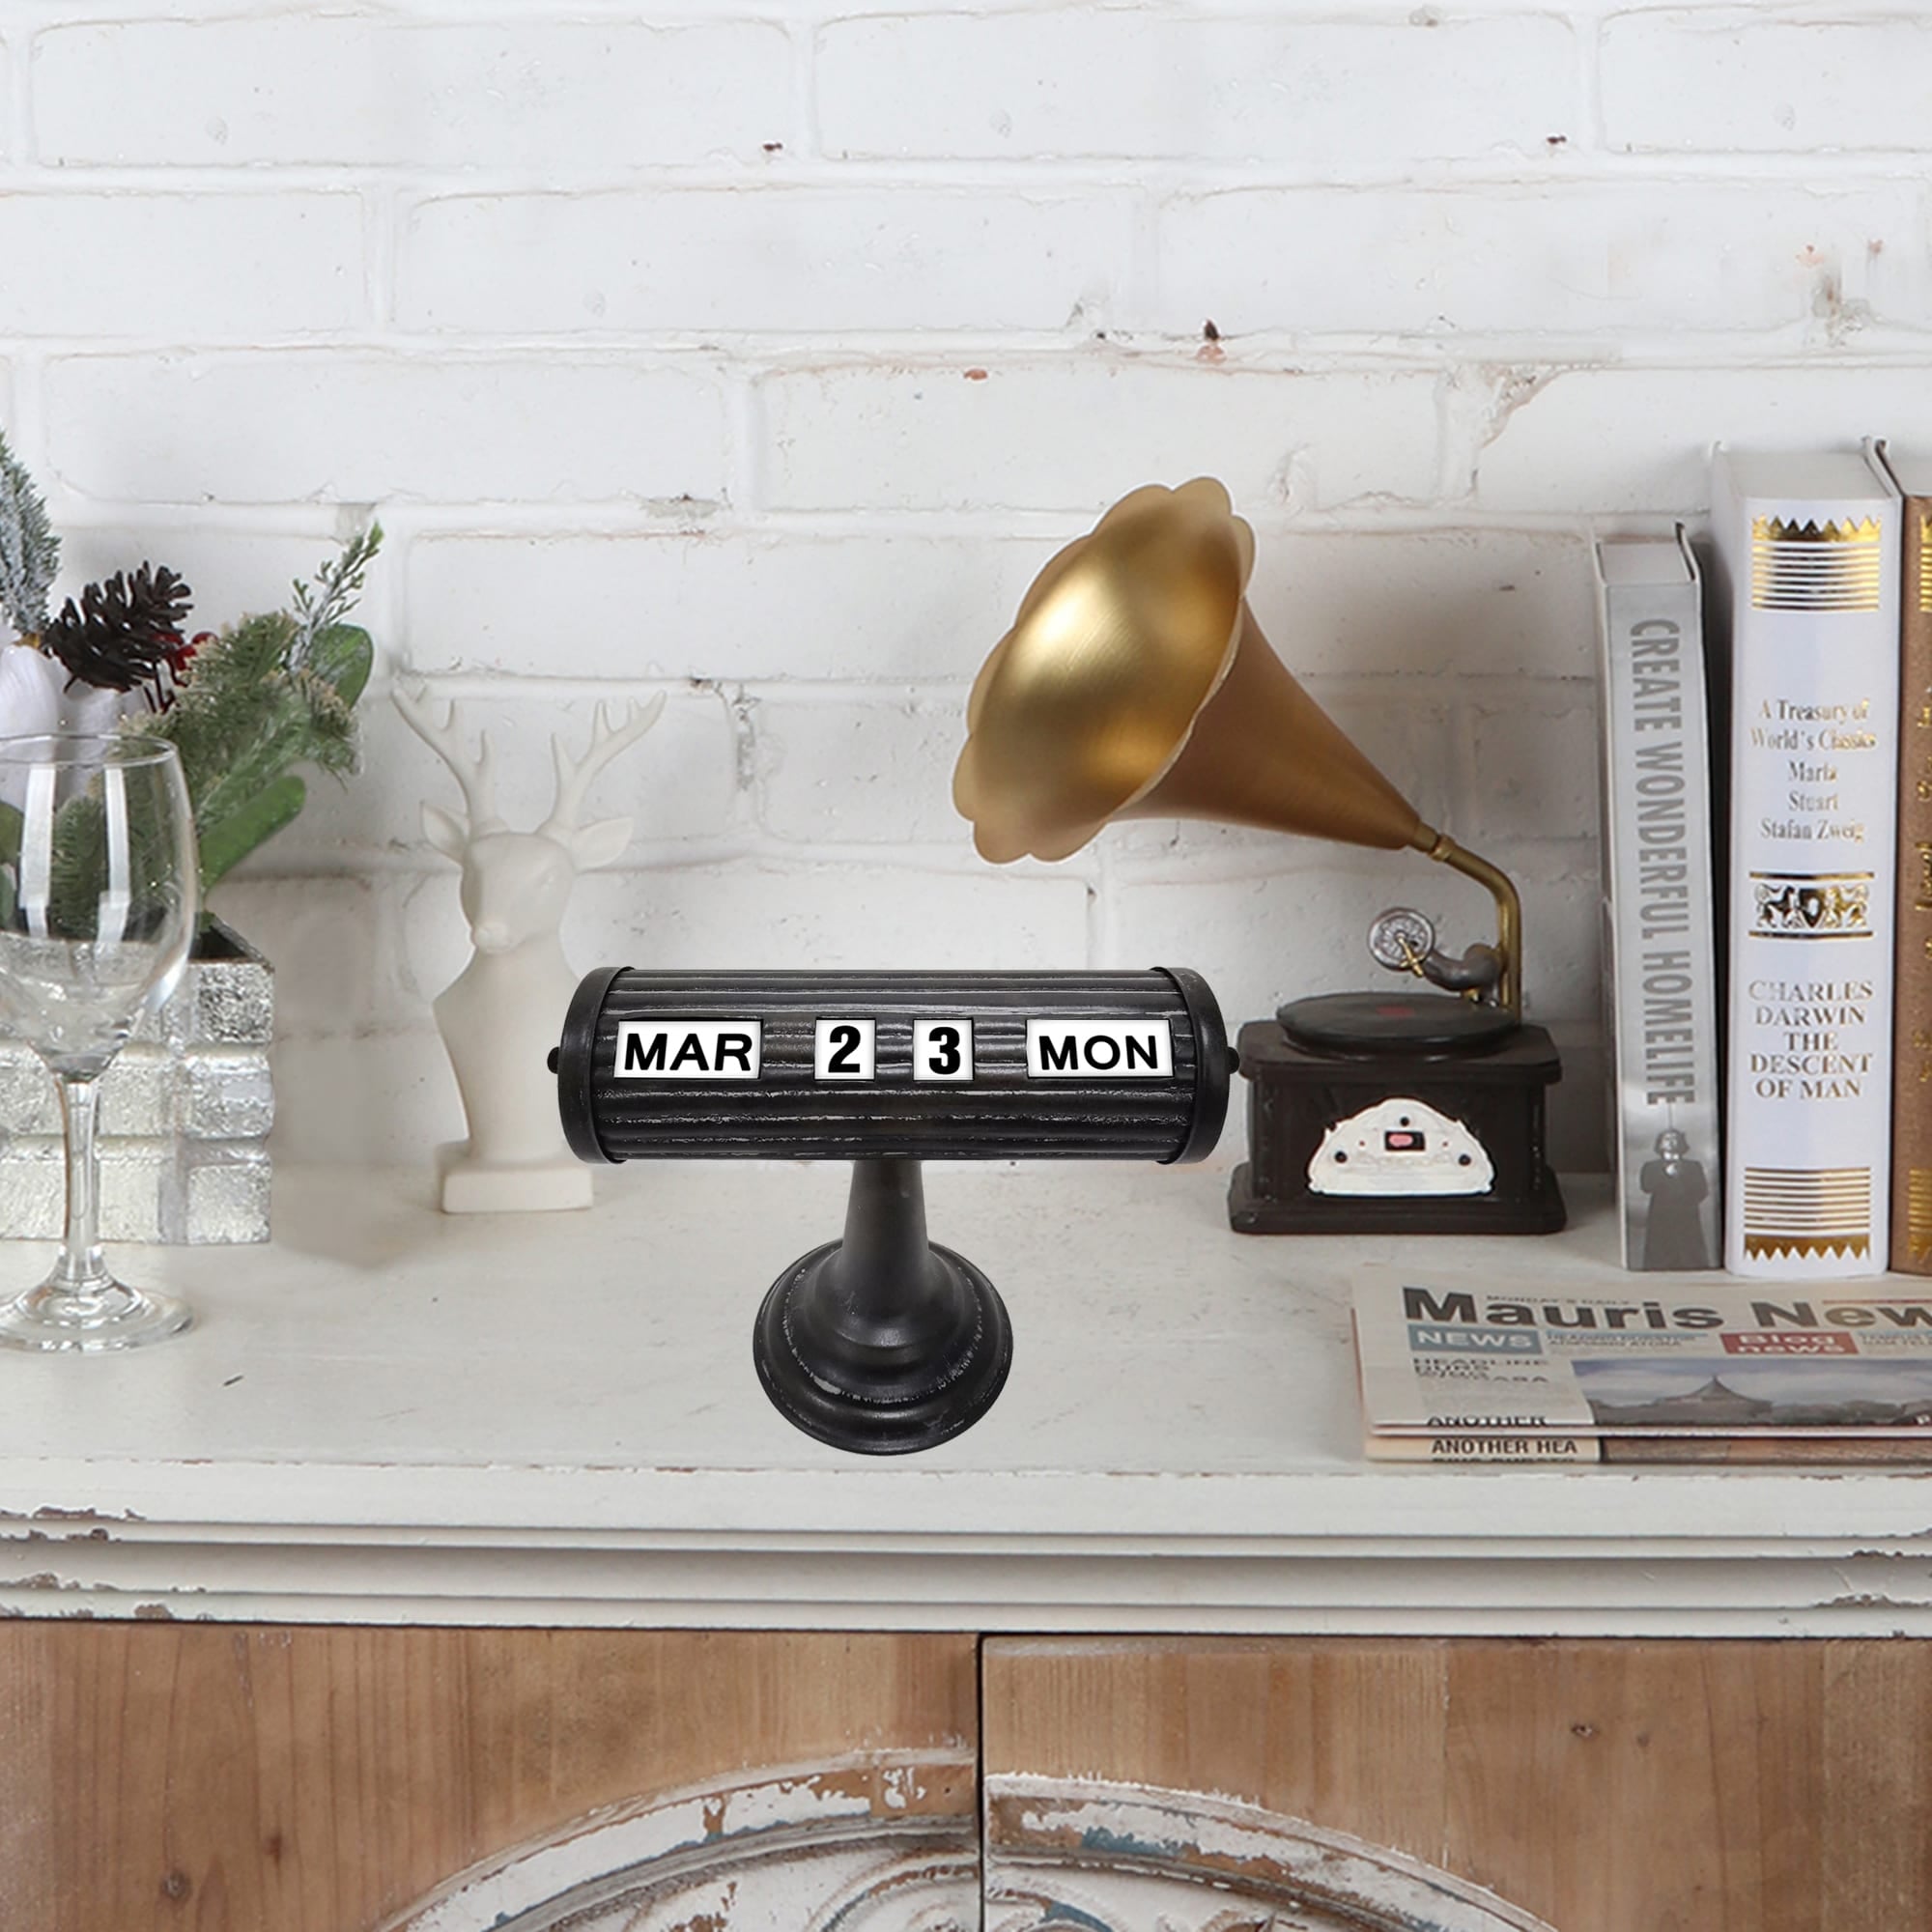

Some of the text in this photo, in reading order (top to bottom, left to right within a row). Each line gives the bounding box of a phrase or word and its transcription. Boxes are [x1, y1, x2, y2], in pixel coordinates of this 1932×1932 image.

[1759, 697, 1870, 725] A Treasury of
[1750, 727, 1877, 751] World's Classics
[1788, 760, 1837, 782] Maria
[1788, 790, 1838, 811] Stuart
[1760, 818, 1865, 843] Stafan Zweig
[1631, 618, 1695, 1105] CREATE WONDERFUL HOMELIFE
[1748, 980, 1873, 1003] CHARLES
[1755, 1006, 1866, 1027] DARWIN
[624, 1025, 1159, 1075] MAR 2 3 MON
[1783, 1032, 1838, 1052] THE
[1750, 1053, 1873, 1075] DESCENT
[1755, 1077, 1861, 1099] OF MAN
[1403, 1287, 1724, 1330] Mauris
[1416, 1329, 1533, 1348] NEWS
[1737, 1345, 1846, 1353] news
[1738, 1333, 1835, 1346] Blog
[1432, 1438, 1577, 1455] ANOTHER HEA
